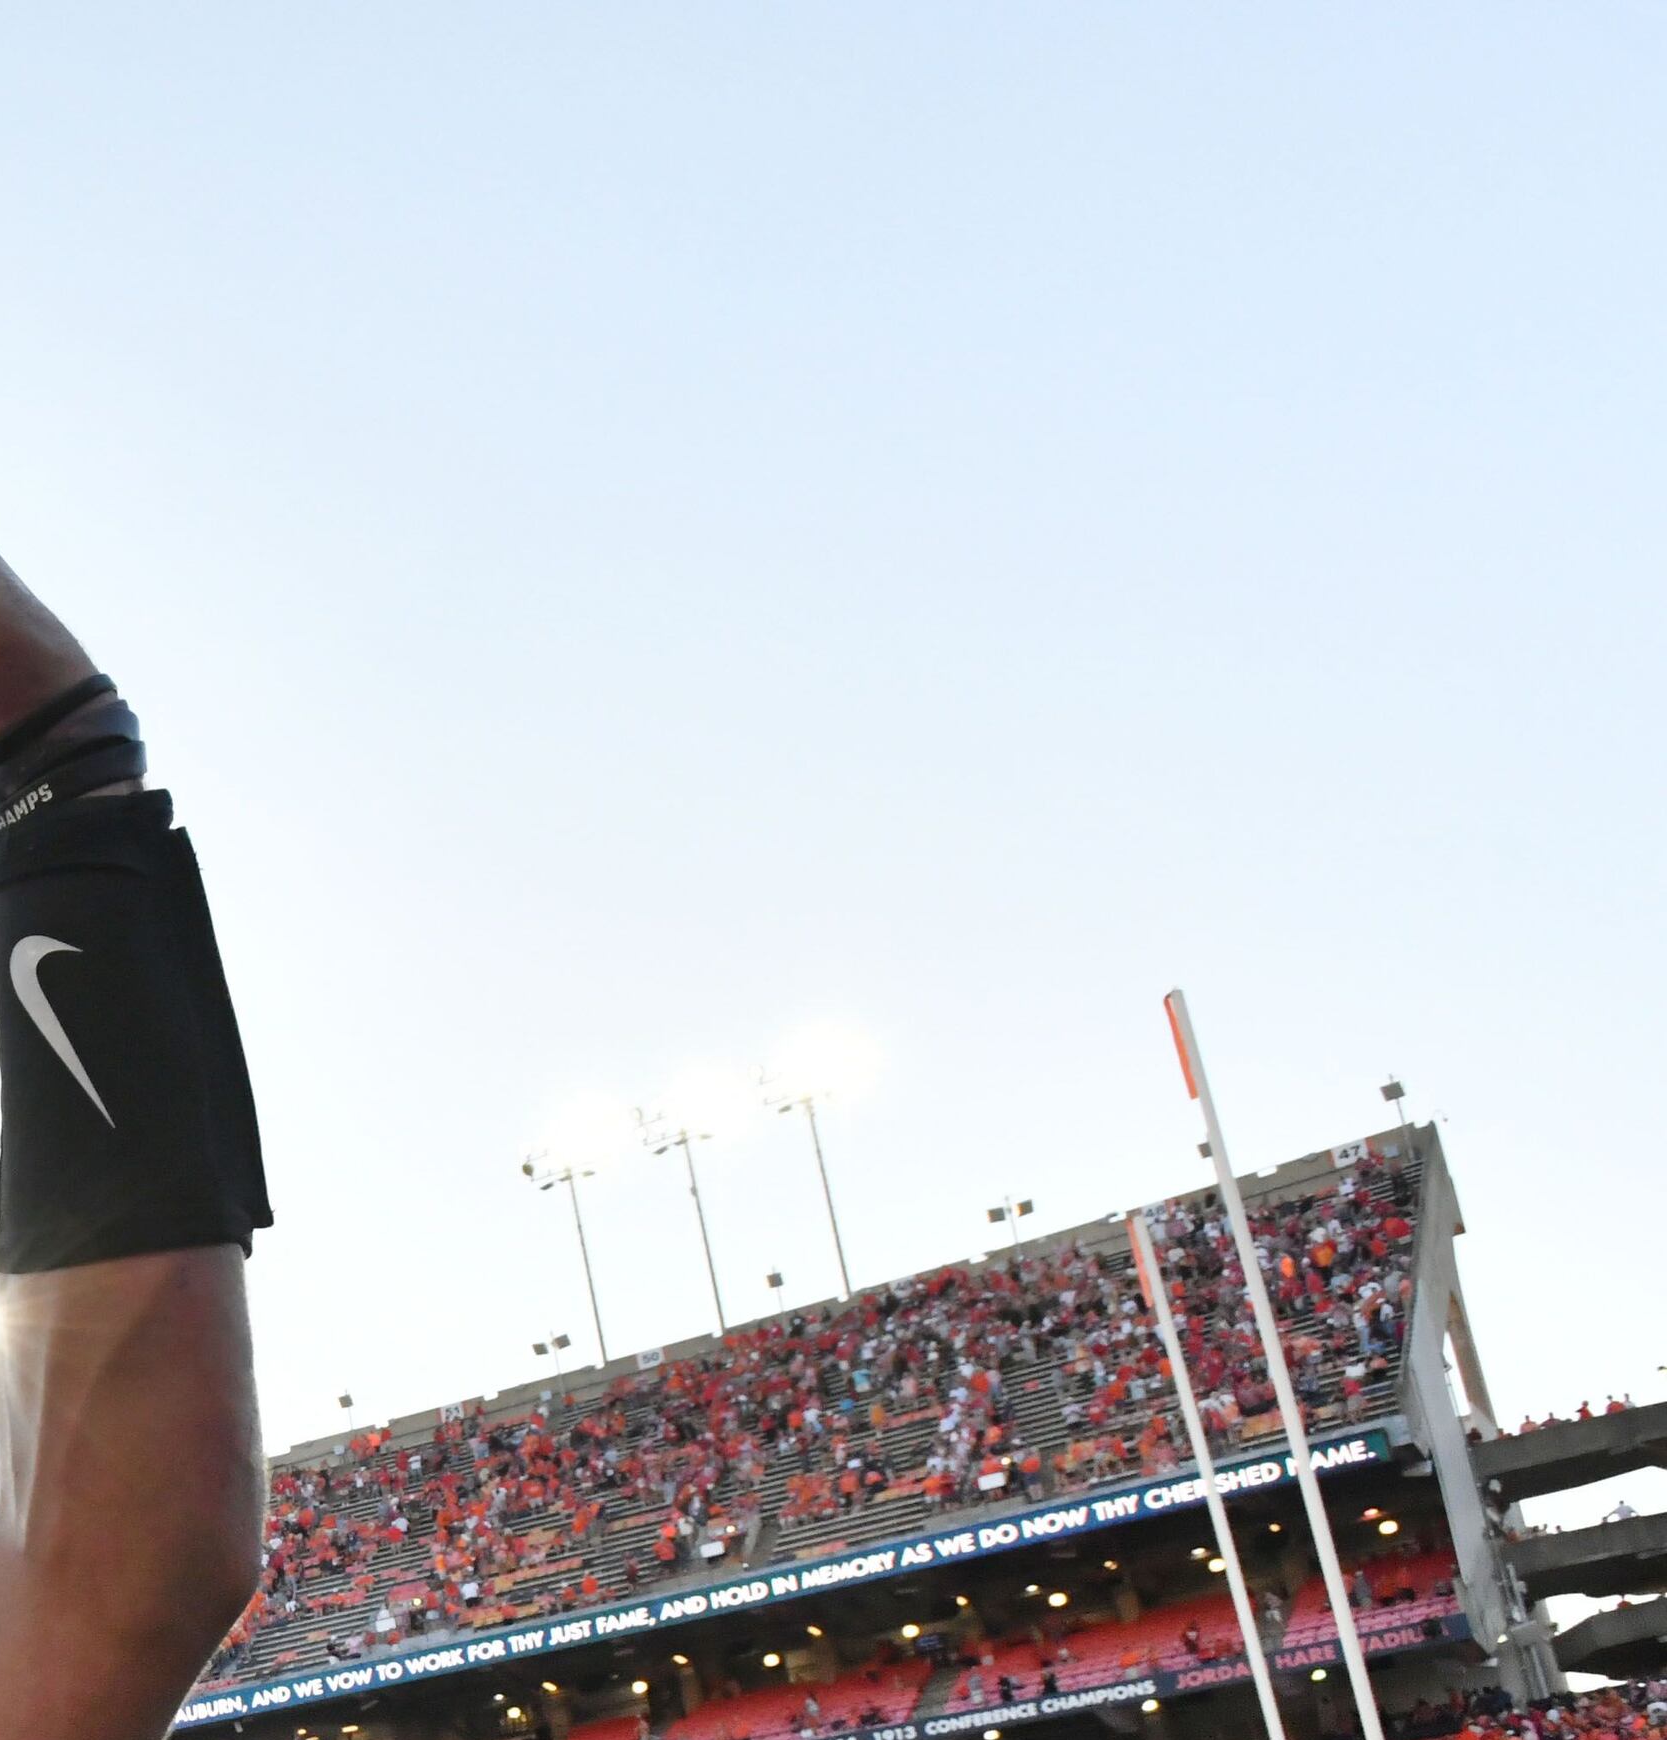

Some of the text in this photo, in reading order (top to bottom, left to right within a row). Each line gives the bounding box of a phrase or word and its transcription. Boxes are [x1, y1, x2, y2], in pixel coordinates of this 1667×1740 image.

[1338, 1145, 1361, 1160] 47
[642, 1350, 660, 1364] 50
[175, 1694, 248, 1725] AUBURN,
[251, 1687, 291, 1709] AND
[294, 1679, 324, 1700] WE
[327, 1667, 373, 1694] VOW
[376, 1661, 403, 1682] TO
[405, 1646, 465, 1677] WORK
[468, 1639, 507, 1665] FOR
[509, 1631, 544, 1656] THY
[549, 1620, 593, 1647] JUST
[595, 1607, 656, 1636] FAME,
[659, 1593, 707, 1621] AND
[710, 1581, 768, 1609] HOLD
[771, 1574, 798, 1595] IN
[801, 1551, 895, 1591] MEMORY
[901, 1543, 933, 1567] AS
[934, 1533, 977, 1557] WE
[978, 1519, 1019, 1546] DO
[1021, 1506, 1089, 1539] NOW
[1091, 1494, 1139, 1522] THY
[1143, 1462, 1283, 1510] CHERSHED
[1175, 1662, 1251, 1690] JORDA
[1275, 1643, 1336, 1670] HARE
[924, 1701, 1039, 1738] CONFERENCE
[1041, 1679, 1157, 1715] CHAMPIONS
